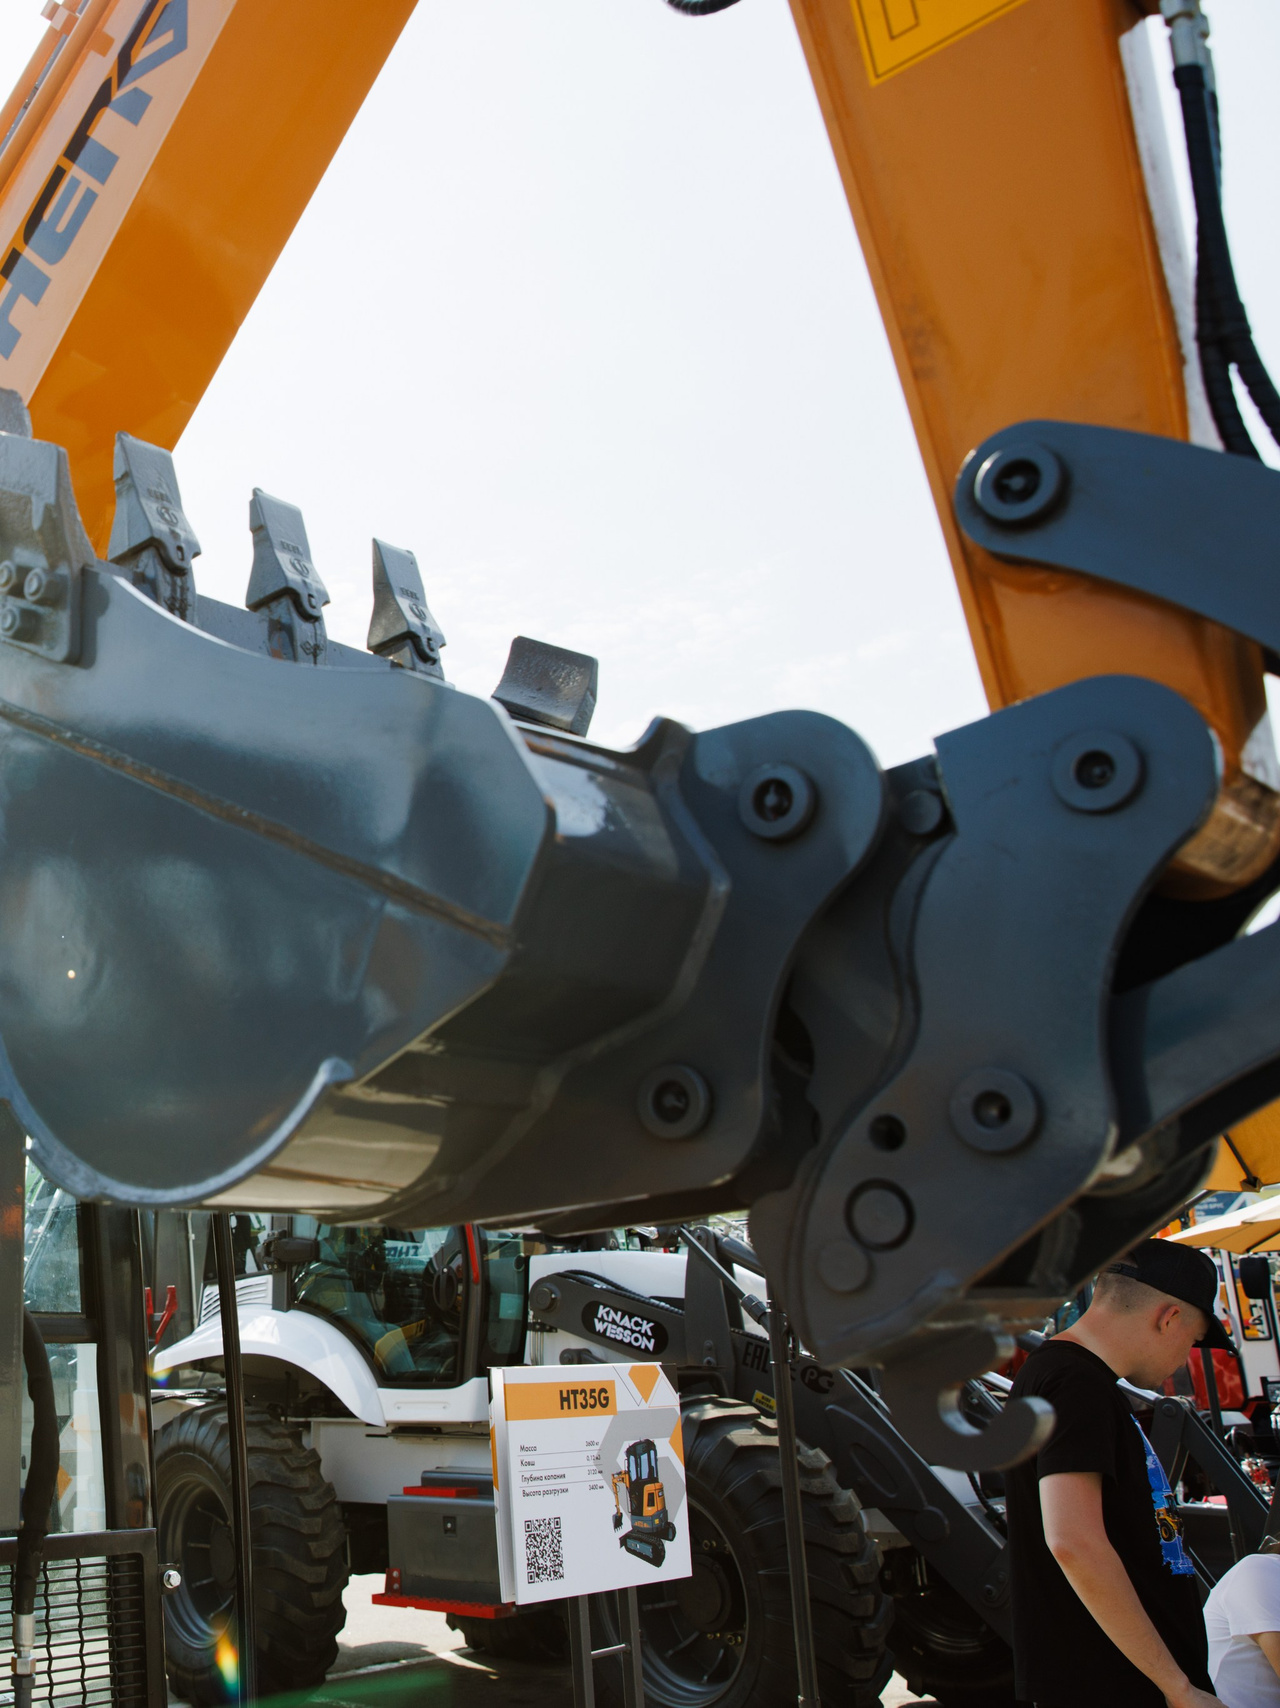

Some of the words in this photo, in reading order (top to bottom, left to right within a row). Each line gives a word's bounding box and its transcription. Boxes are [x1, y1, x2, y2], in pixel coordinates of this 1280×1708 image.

[597, 1304, 654, 1337] KNACK
[593, 1318, 655, 1352] WESSON
[559, 1388, 610, 1410] HT35G
[520, 1445, 537, 1453] Масса
[520, 1459, 536, 1467] Ковш
[521, 1473, 543, 1484] Глубина
[544, 1473, 566, 1481] копания
[522, 1489, 541, 1498] Высота
[542, 1487, 569, 1498] разгрузки
